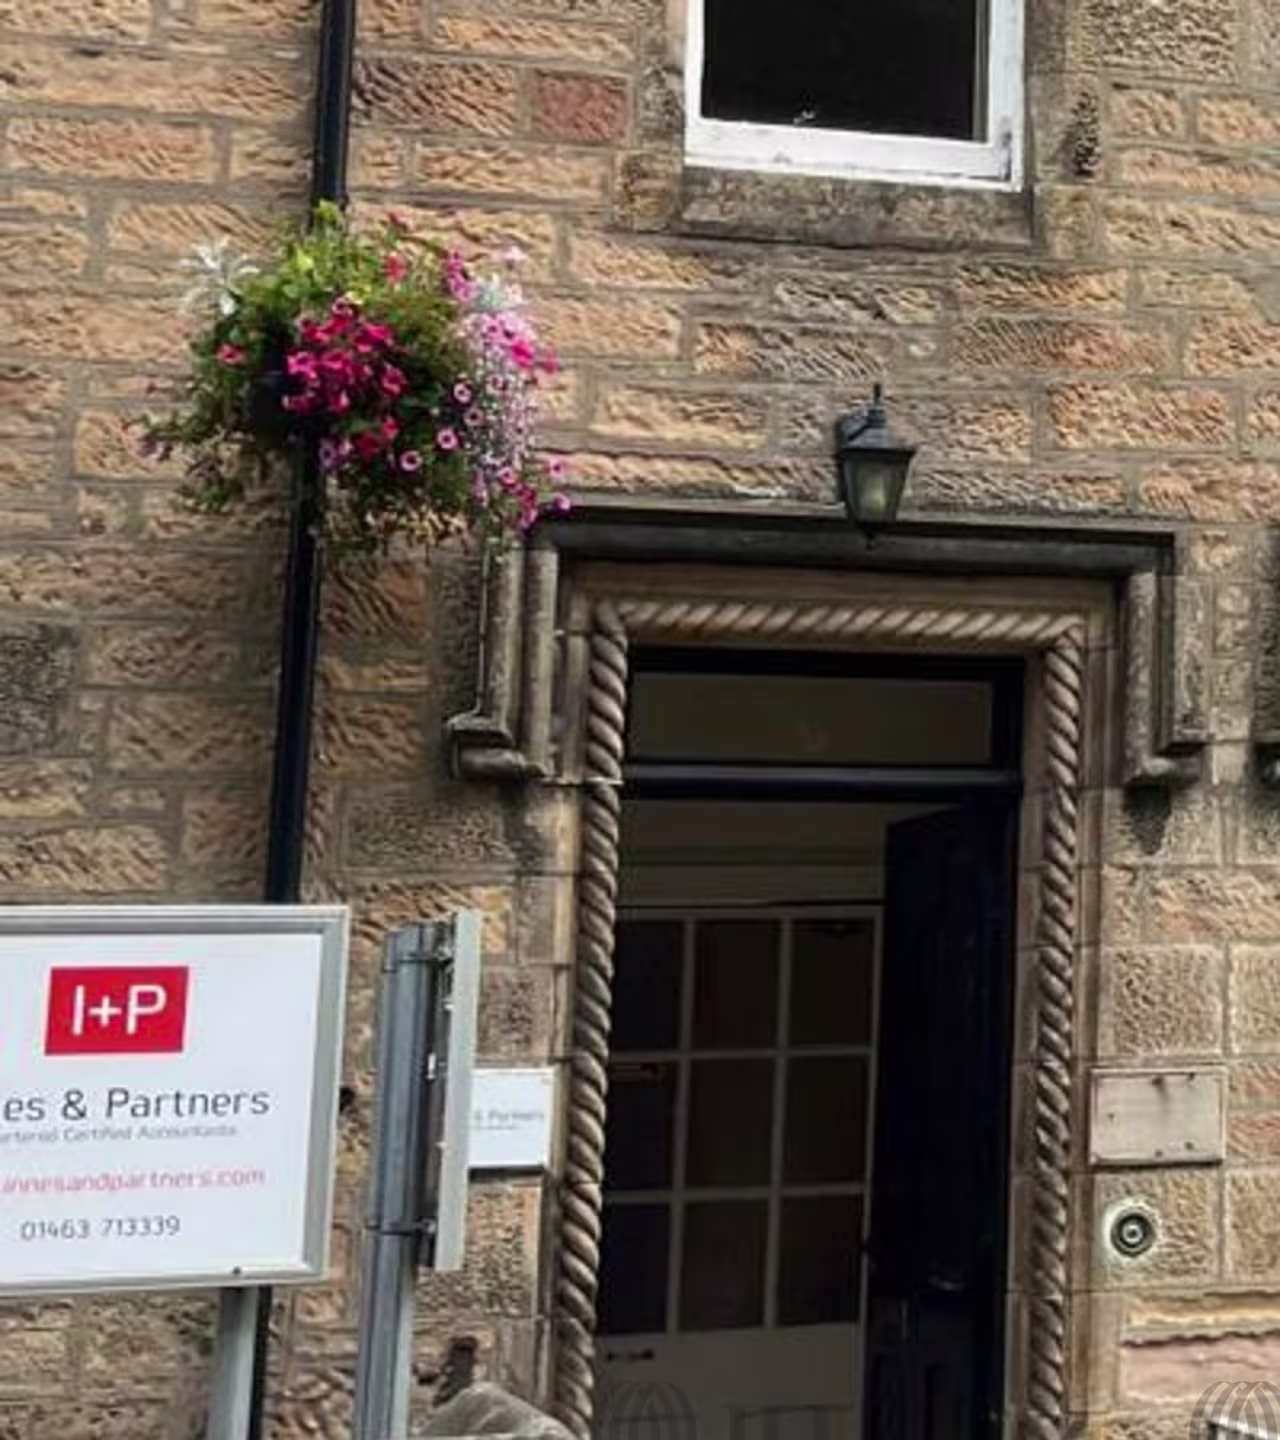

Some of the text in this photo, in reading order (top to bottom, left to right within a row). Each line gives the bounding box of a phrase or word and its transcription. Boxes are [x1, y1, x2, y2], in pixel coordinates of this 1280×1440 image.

[60, 1088, 88, 1121] &
[105, 1086, 271, 1119] Partners
[63, 1125, 132, 1143] Certified
[136, 1124, 238, 1140] Accountants
[20, 1215, 182, 1242] 01463 713339
